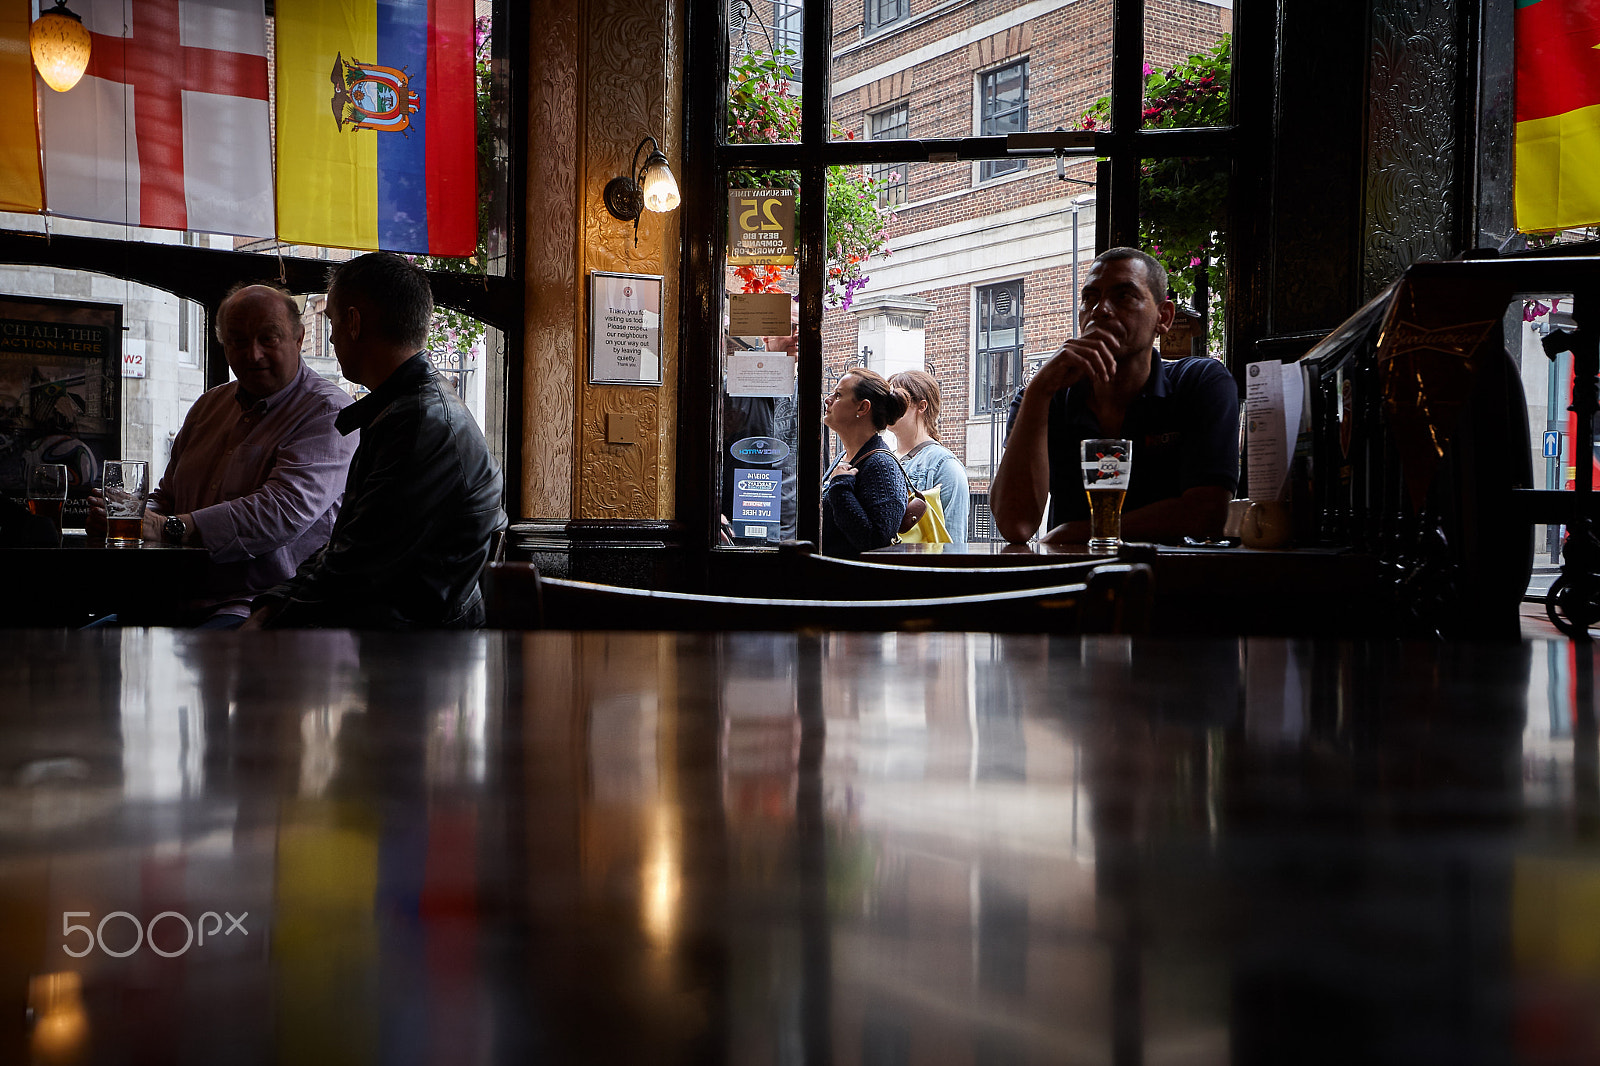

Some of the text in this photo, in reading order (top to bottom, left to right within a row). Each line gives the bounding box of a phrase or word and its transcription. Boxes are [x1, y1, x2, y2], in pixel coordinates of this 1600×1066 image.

[0, 323, 102, 342] CH ALL THE
[1, 337, 104, 353] ACTION HERE
[622, 347, 642, 355] leaving
[124, 354, 142, 364] W2
